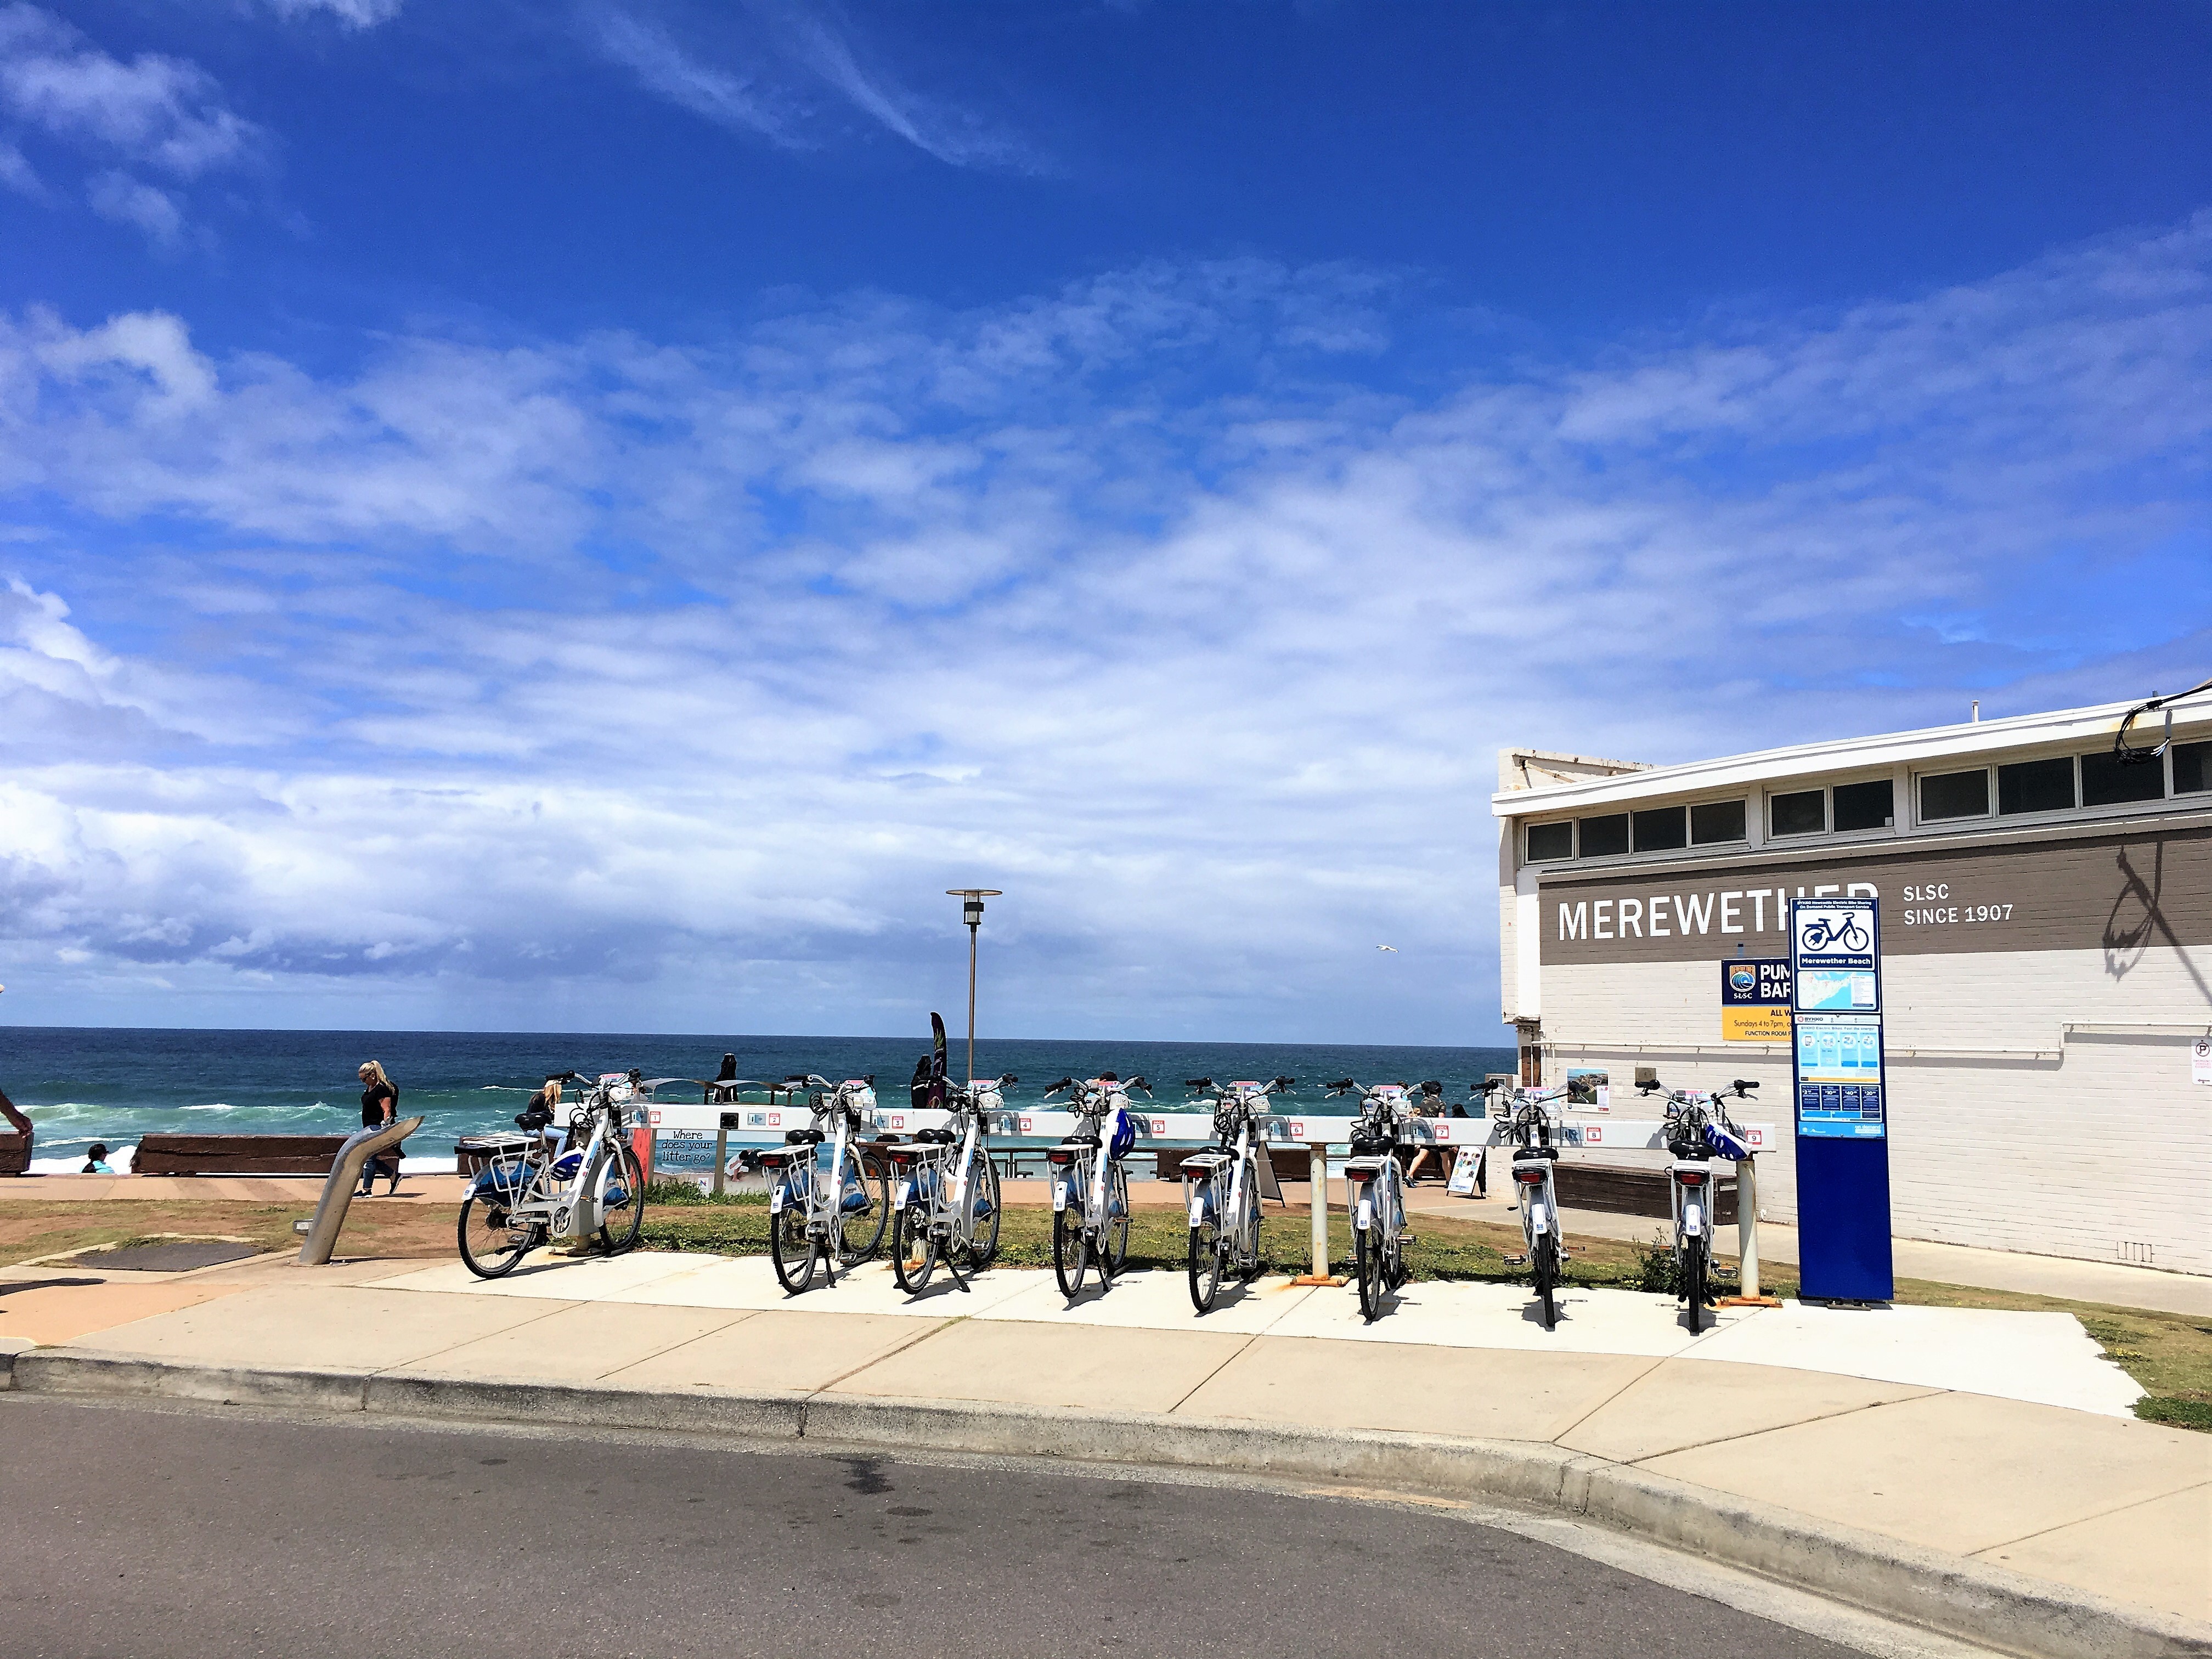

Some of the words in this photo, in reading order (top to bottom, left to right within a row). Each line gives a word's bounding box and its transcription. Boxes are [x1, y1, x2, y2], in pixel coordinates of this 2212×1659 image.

[1903, 883, 1949, 901] SLSC
[1559, 882, 1879, 941] MEREWETH
[1904, 907, 1959, 925] SINCE
[1965, 904, 2013, 922] 1907
[1734, 1020, 1758, 1028] Sundays
[1770, 1020, 1785, 1028] 7pm,
[673, 1129, 703, 1139] Where
[662, 1139, 686, 1149] does
[688, 1142, 713, 1151] your
[662, 1150, 691, 1161] litter
[693, 1153, 711, 1164] go?
